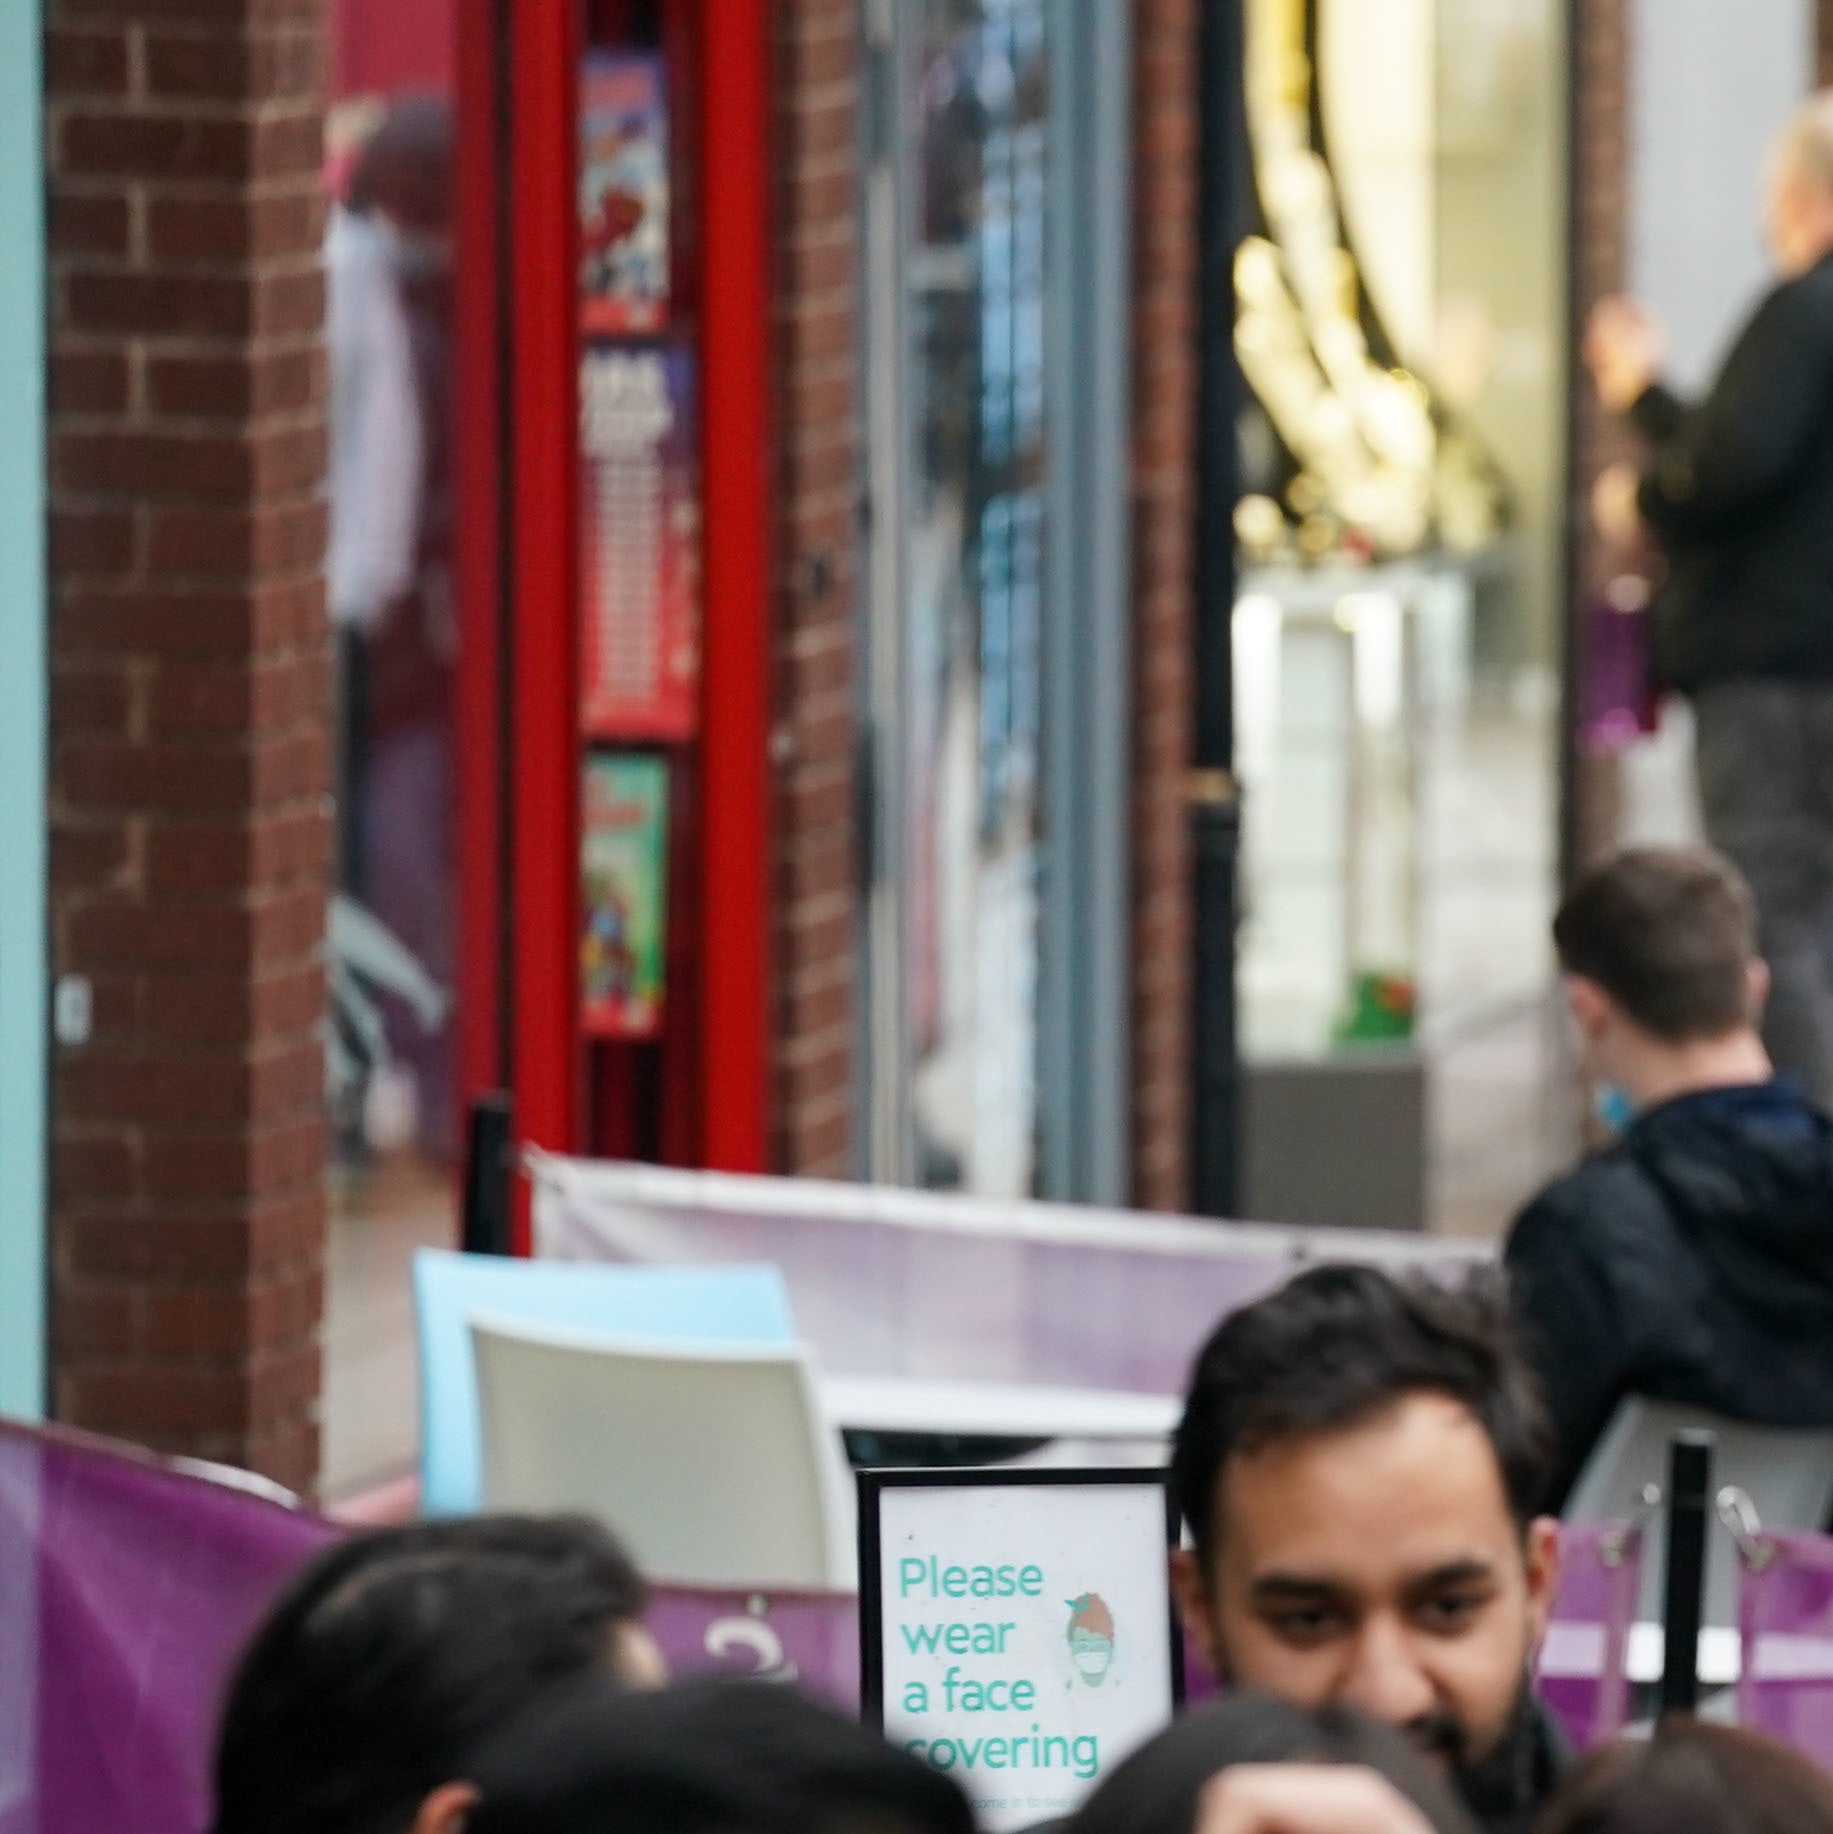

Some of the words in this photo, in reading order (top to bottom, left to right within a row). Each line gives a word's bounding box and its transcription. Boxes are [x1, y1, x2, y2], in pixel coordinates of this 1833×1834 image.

[899, 1554, 1044, 1598] Please
[901, 1621, 1016, 1655] wear
[902, 1681, 929, 1714] a
[941, 1666, 1036, 1713] face
